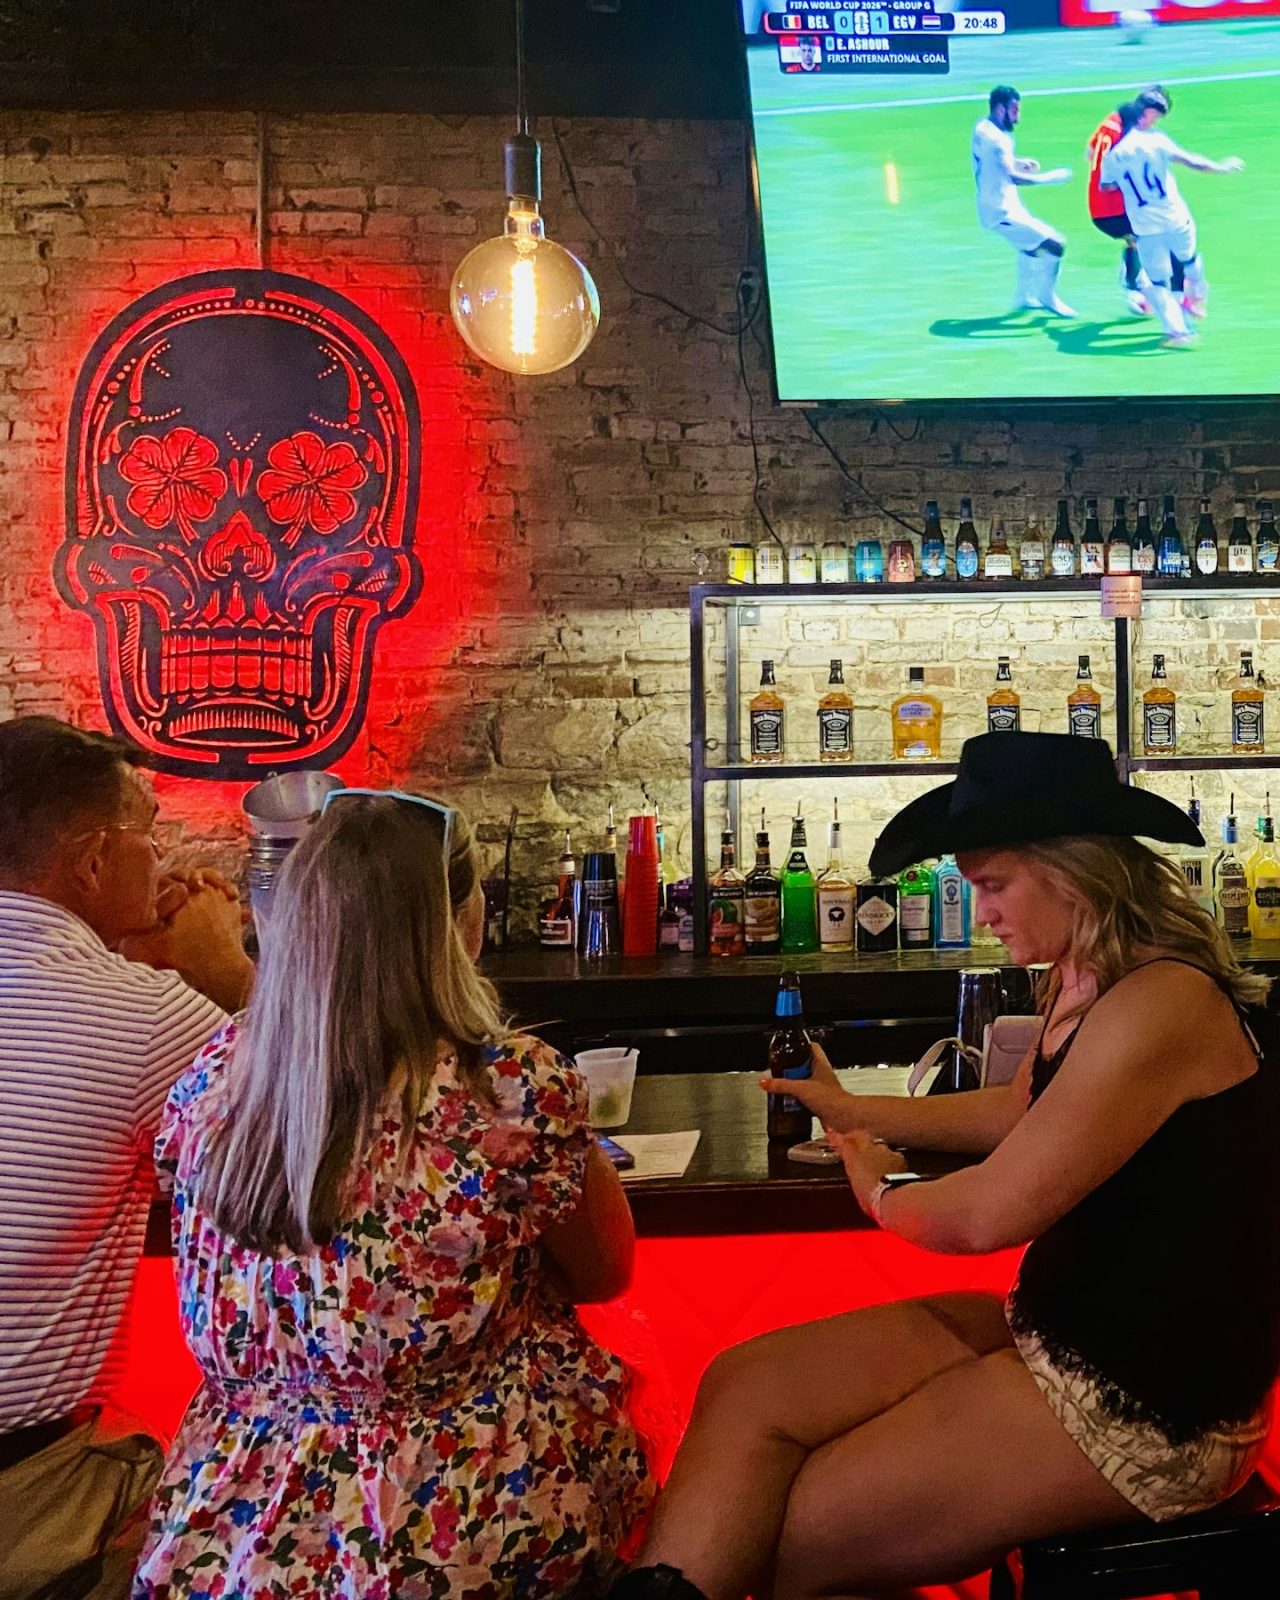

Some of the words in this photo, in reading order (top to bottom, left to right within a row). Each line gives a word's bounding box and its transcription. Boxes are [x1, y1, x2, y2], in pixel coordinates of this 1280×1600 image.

[790, 1, 809, 10] FIFA
[810, 1, 841, 10] WORLD
[842, 1, 860, 10] CUP
[893, 1, 923, 10] GROUP
[807, 15, 829, 29] BEL
[840, 16, 848, 28] 0
[964, 17, 998, 29] 20:48
[848, 37, 889, 50] ASHOUR
[827, 54, 850, 63] FIRST
[852, 54, 921, 64] INTERNATIONAL
[923, 54, 946, 64] GOAL
[1123, 160, 1166, 208] 14
